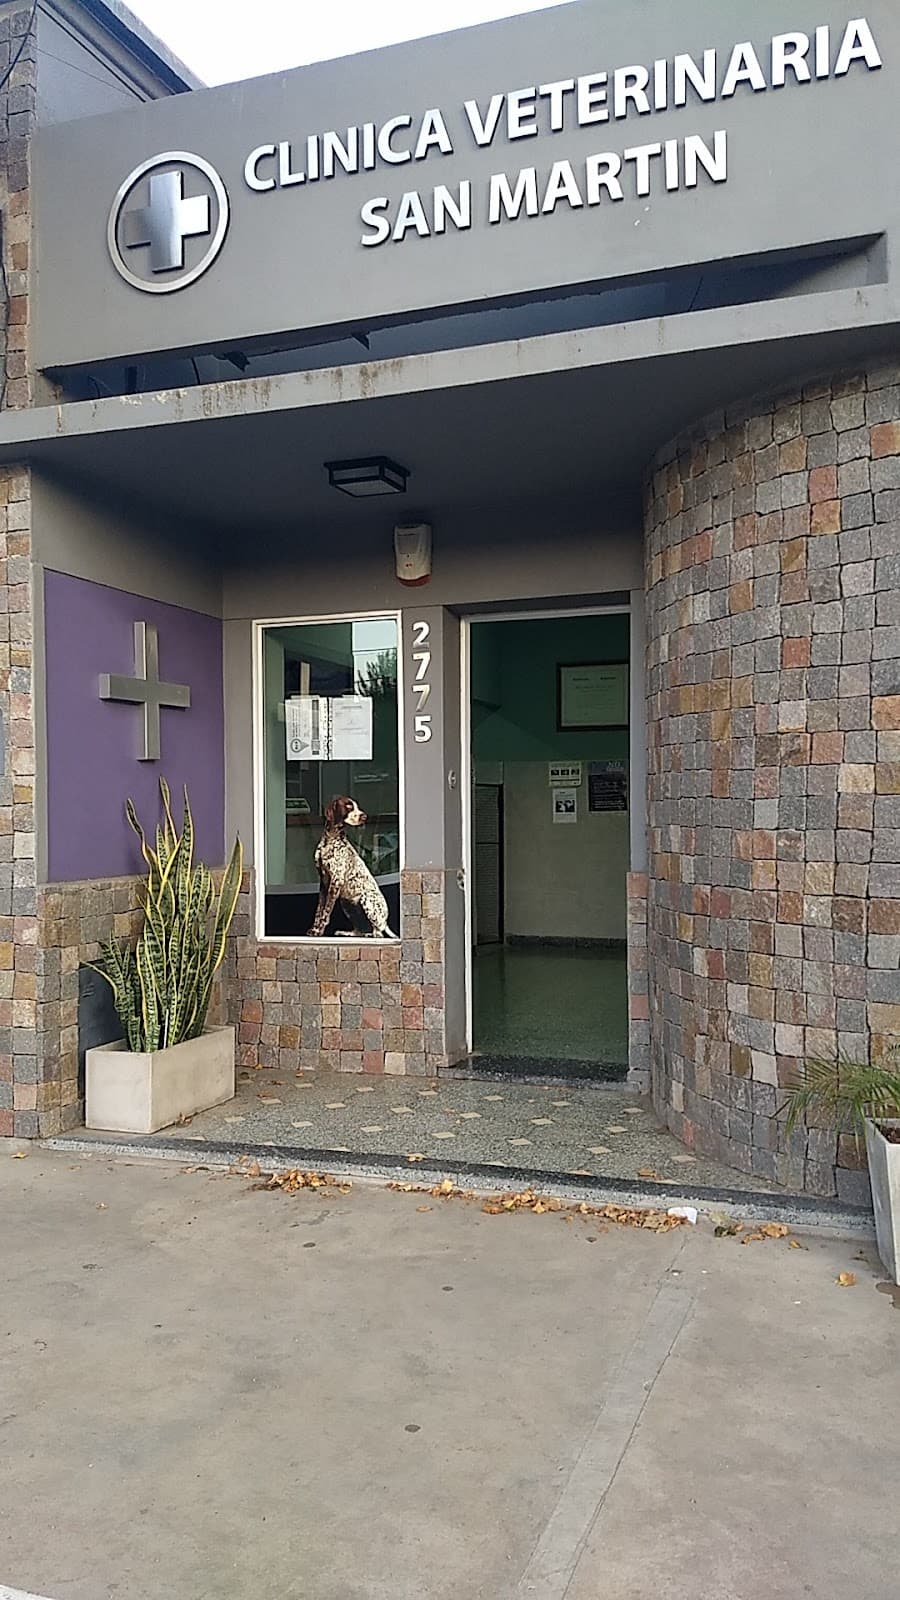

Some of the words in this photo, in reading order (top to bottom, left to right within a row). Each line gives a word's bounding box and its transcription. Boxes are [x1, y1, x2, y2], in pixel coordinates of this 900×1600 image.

[244, 109, 452, 191] CLINICA
[463, 18, 881, 146] VETERINARIA
[360, 180, 472, 247] SAN
[488, 130, 728, 222] MARTIN
[412, 621, 432, 742] 2775
